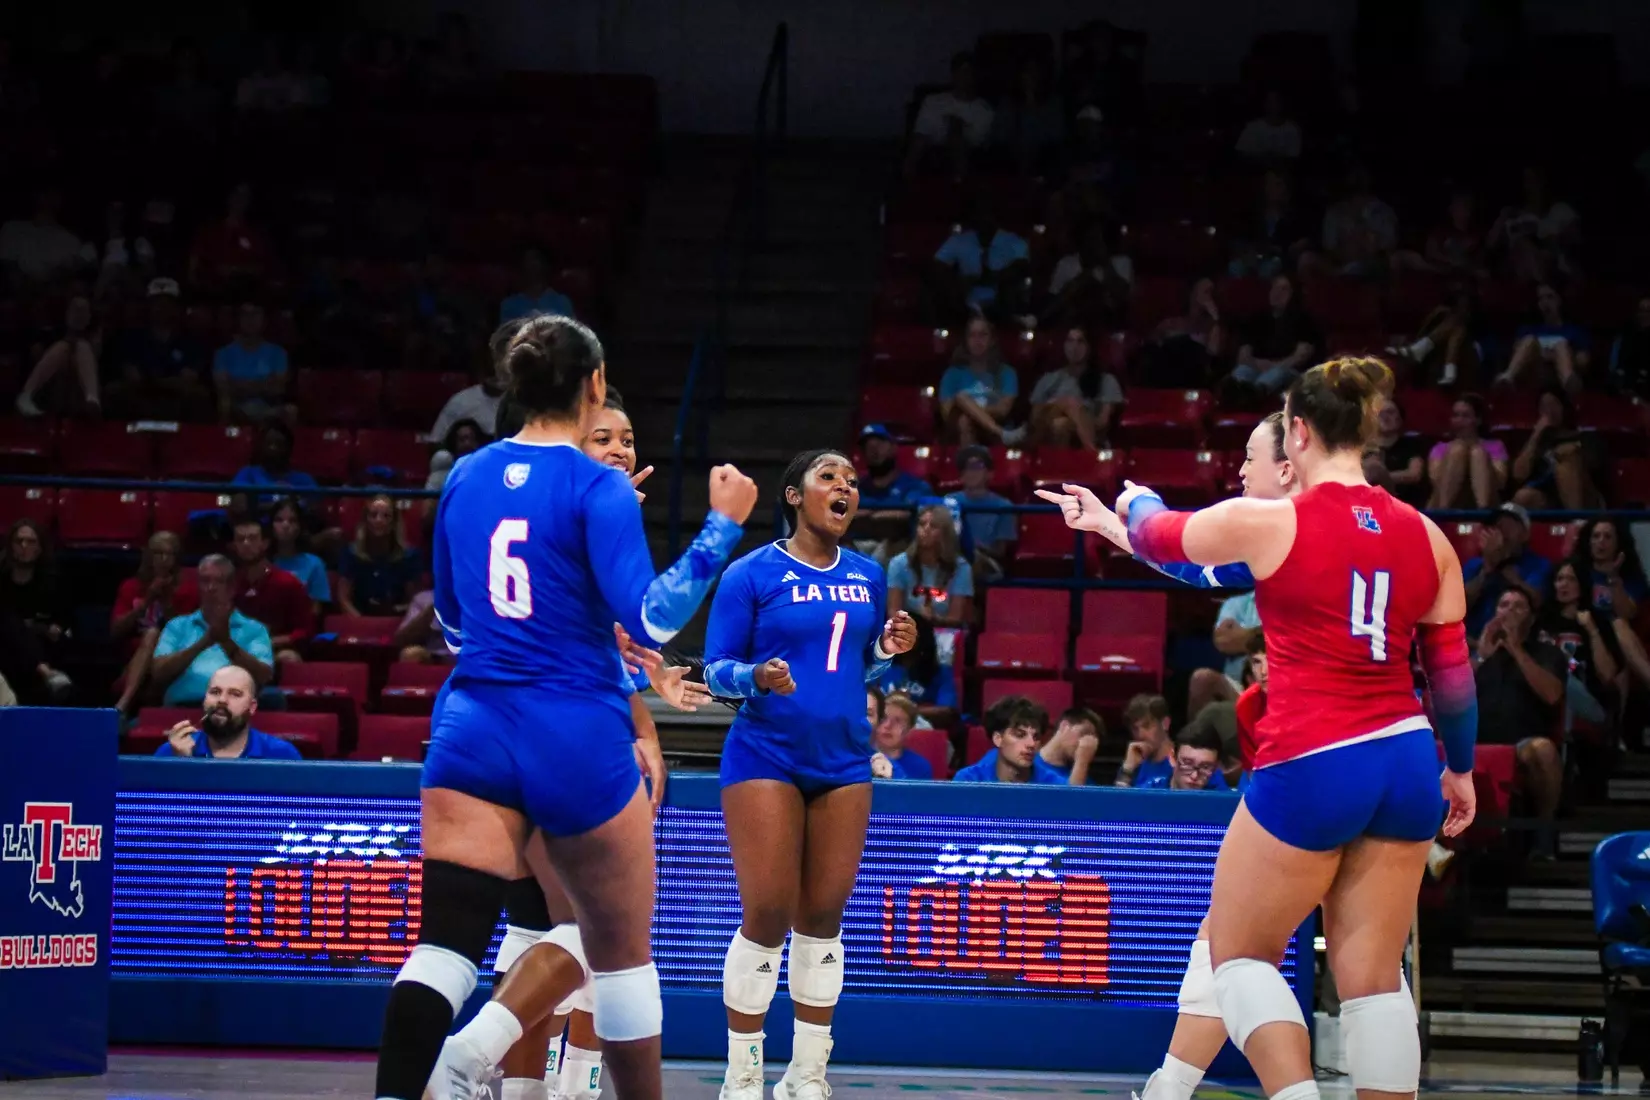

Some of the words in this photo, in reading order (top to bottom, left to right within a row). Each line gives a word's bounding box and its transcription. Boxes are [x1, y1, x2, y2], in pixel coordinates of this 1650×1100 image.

[489, 518, 533, 620] 6
[792, 584, 823, 603] LA
[826, 584, 871, 603] TECH
[826, 611, 847, 672] 1
[1350, 569, 1390, 662] 4
[2, 824, 34, 861] LA
[224, 857, 421, 964] LOUDE
[883, 875, 1110, 985] LOUDER
[0, 934, 97, 969] BULLDOGS
